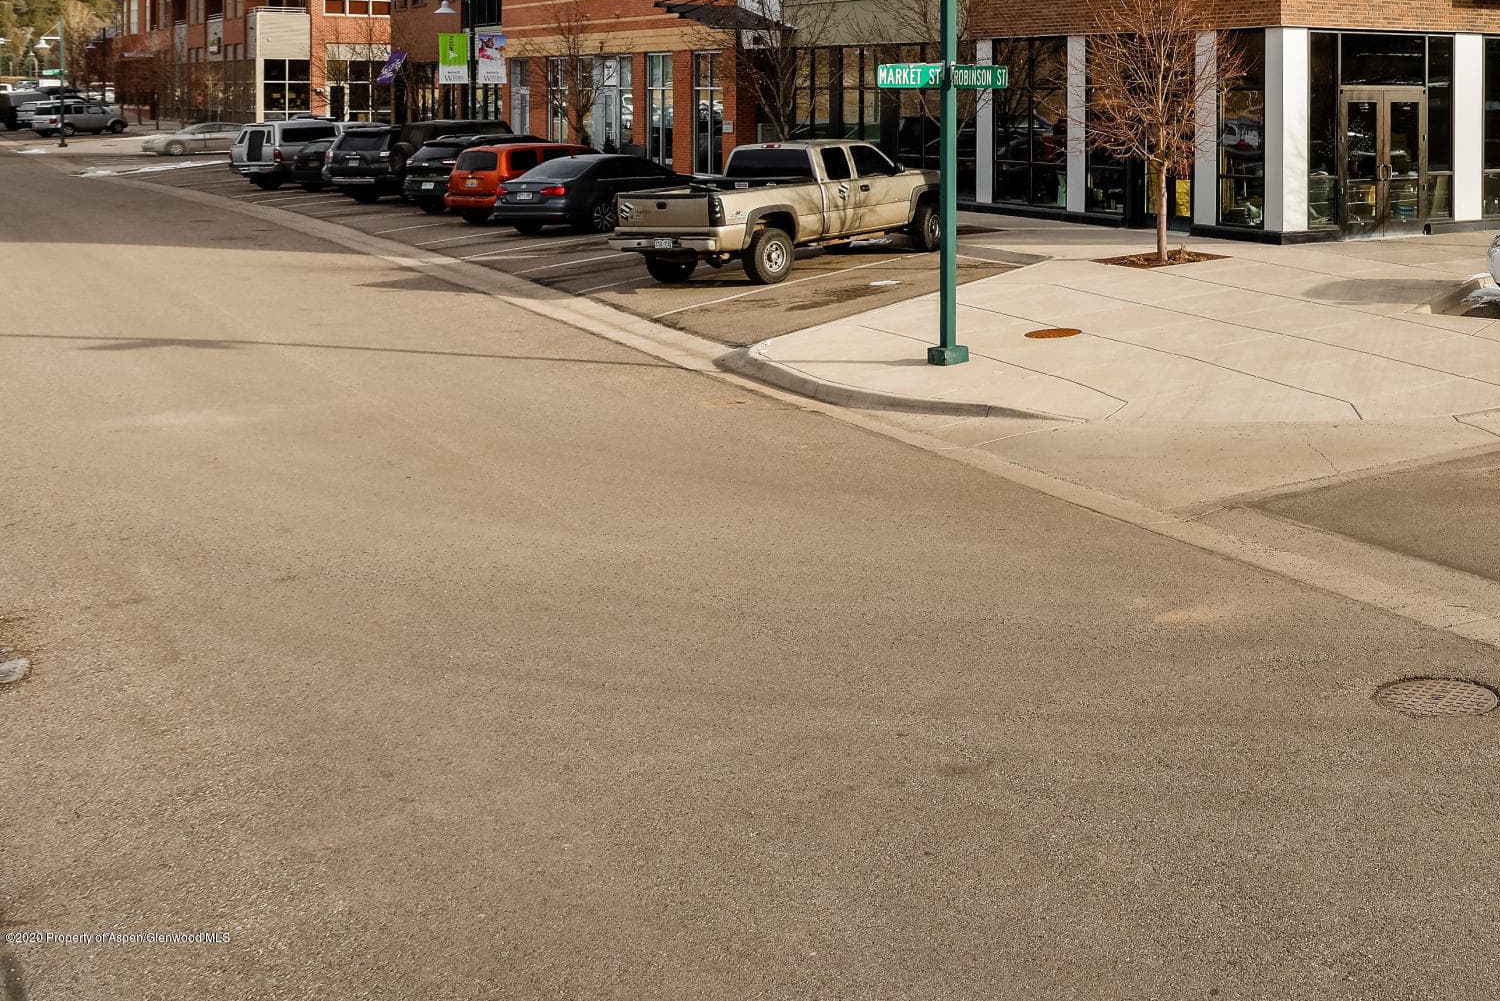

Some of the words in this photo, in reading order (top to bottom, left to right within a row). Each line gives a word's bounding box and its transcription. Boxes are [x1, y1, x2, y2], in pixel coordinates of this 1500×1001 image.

[878, 68, 922, 85] MARKET
[928, 68, 942, 85] ST
[953, 69, 992, 86] ROBINSON
[997, 69, 1007, 86] ST
